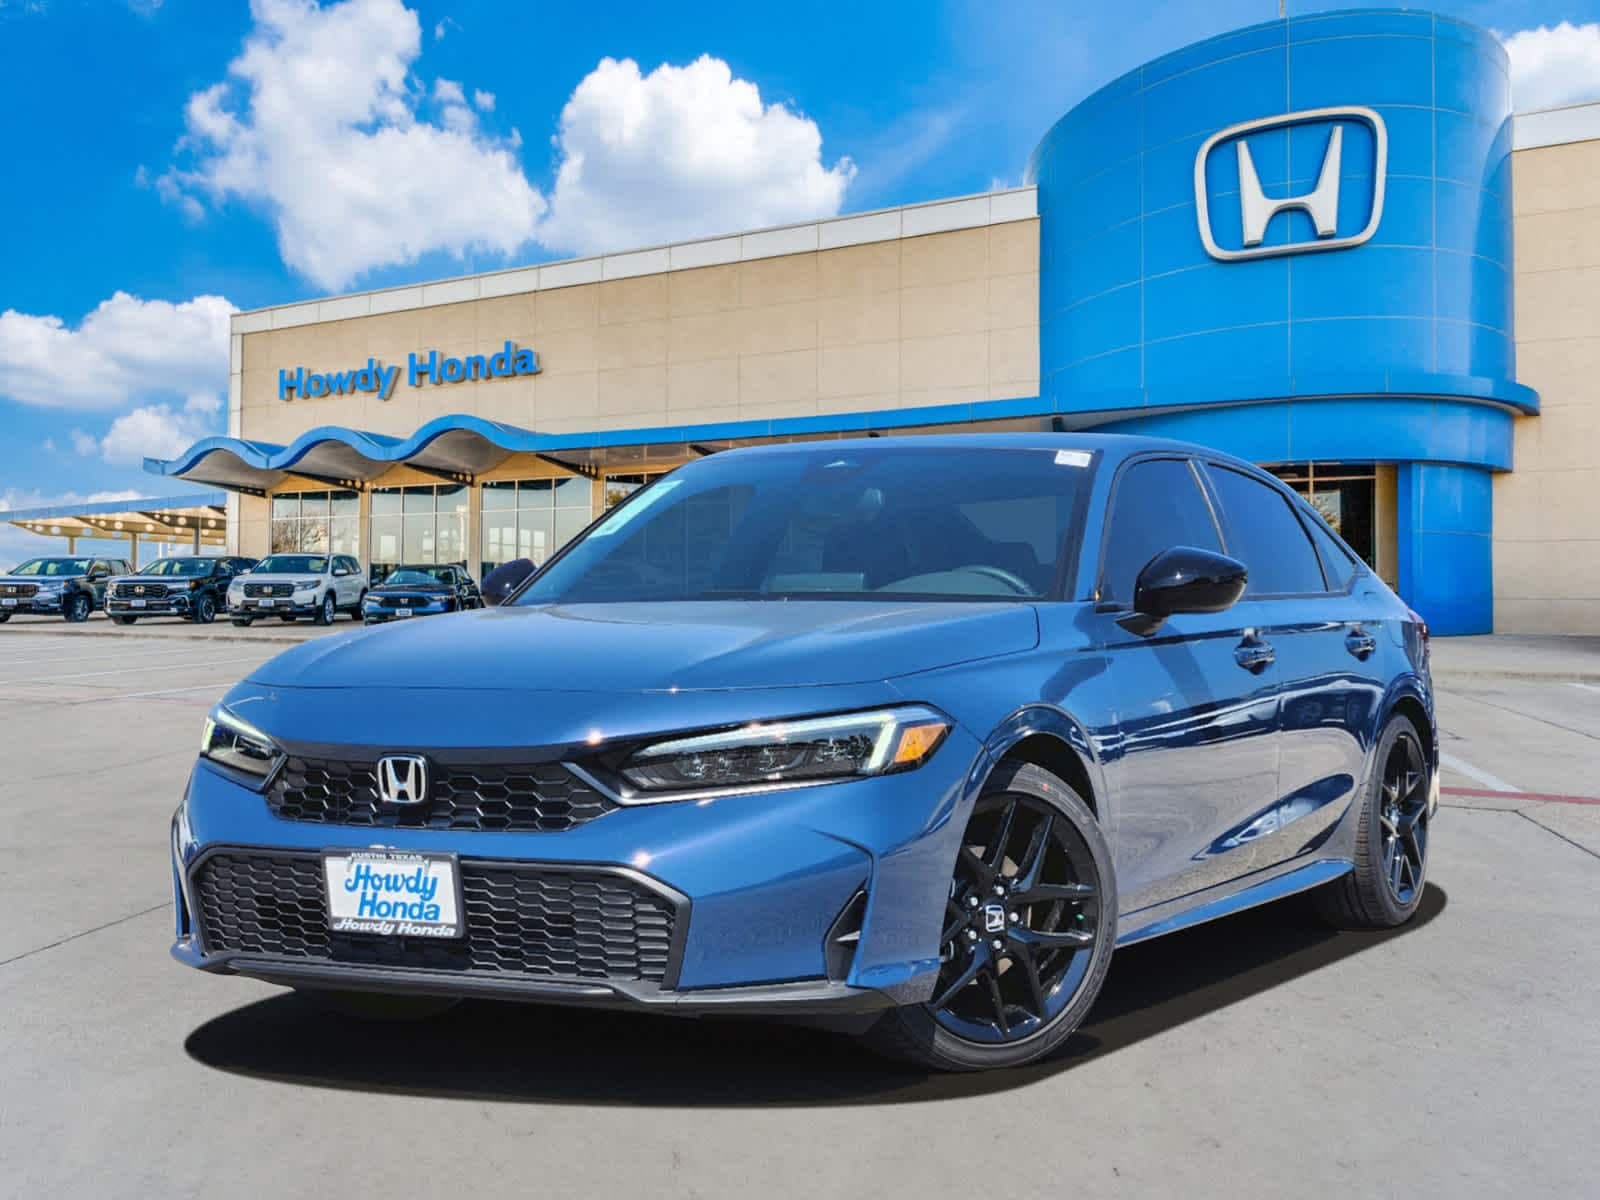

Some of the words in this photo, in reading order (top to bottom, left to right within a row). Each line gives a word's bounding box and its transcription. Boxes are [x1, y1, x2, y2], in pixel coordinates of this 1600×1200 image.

[278, 358, 399, 401] Howdy
[407, 340, 541, 387] Honda
[344, 864, 439, 901] Howdy
[357, 891, 441, 921] Honda
[333, 919, 395, 935] Howdy
[397, 922, 456, 937] Honda
